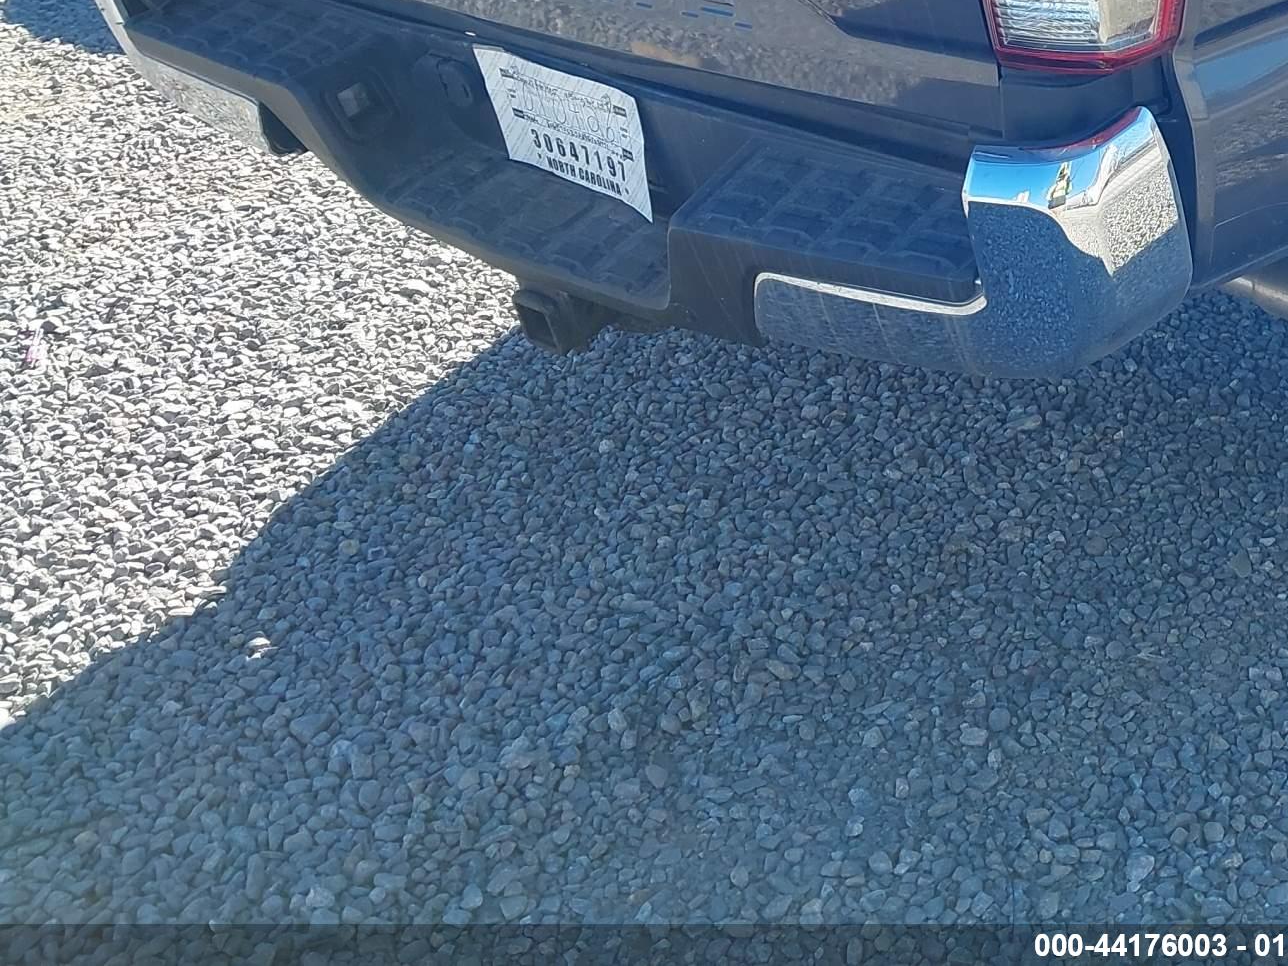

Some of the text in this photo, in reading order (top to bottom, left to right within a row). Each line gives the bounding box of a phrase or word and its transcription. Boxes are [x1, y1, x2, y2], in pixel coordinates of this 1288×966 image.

[530, 128, 627, 182] 30647197
[546, 155, 623, 196] NORTH CAROLINA
